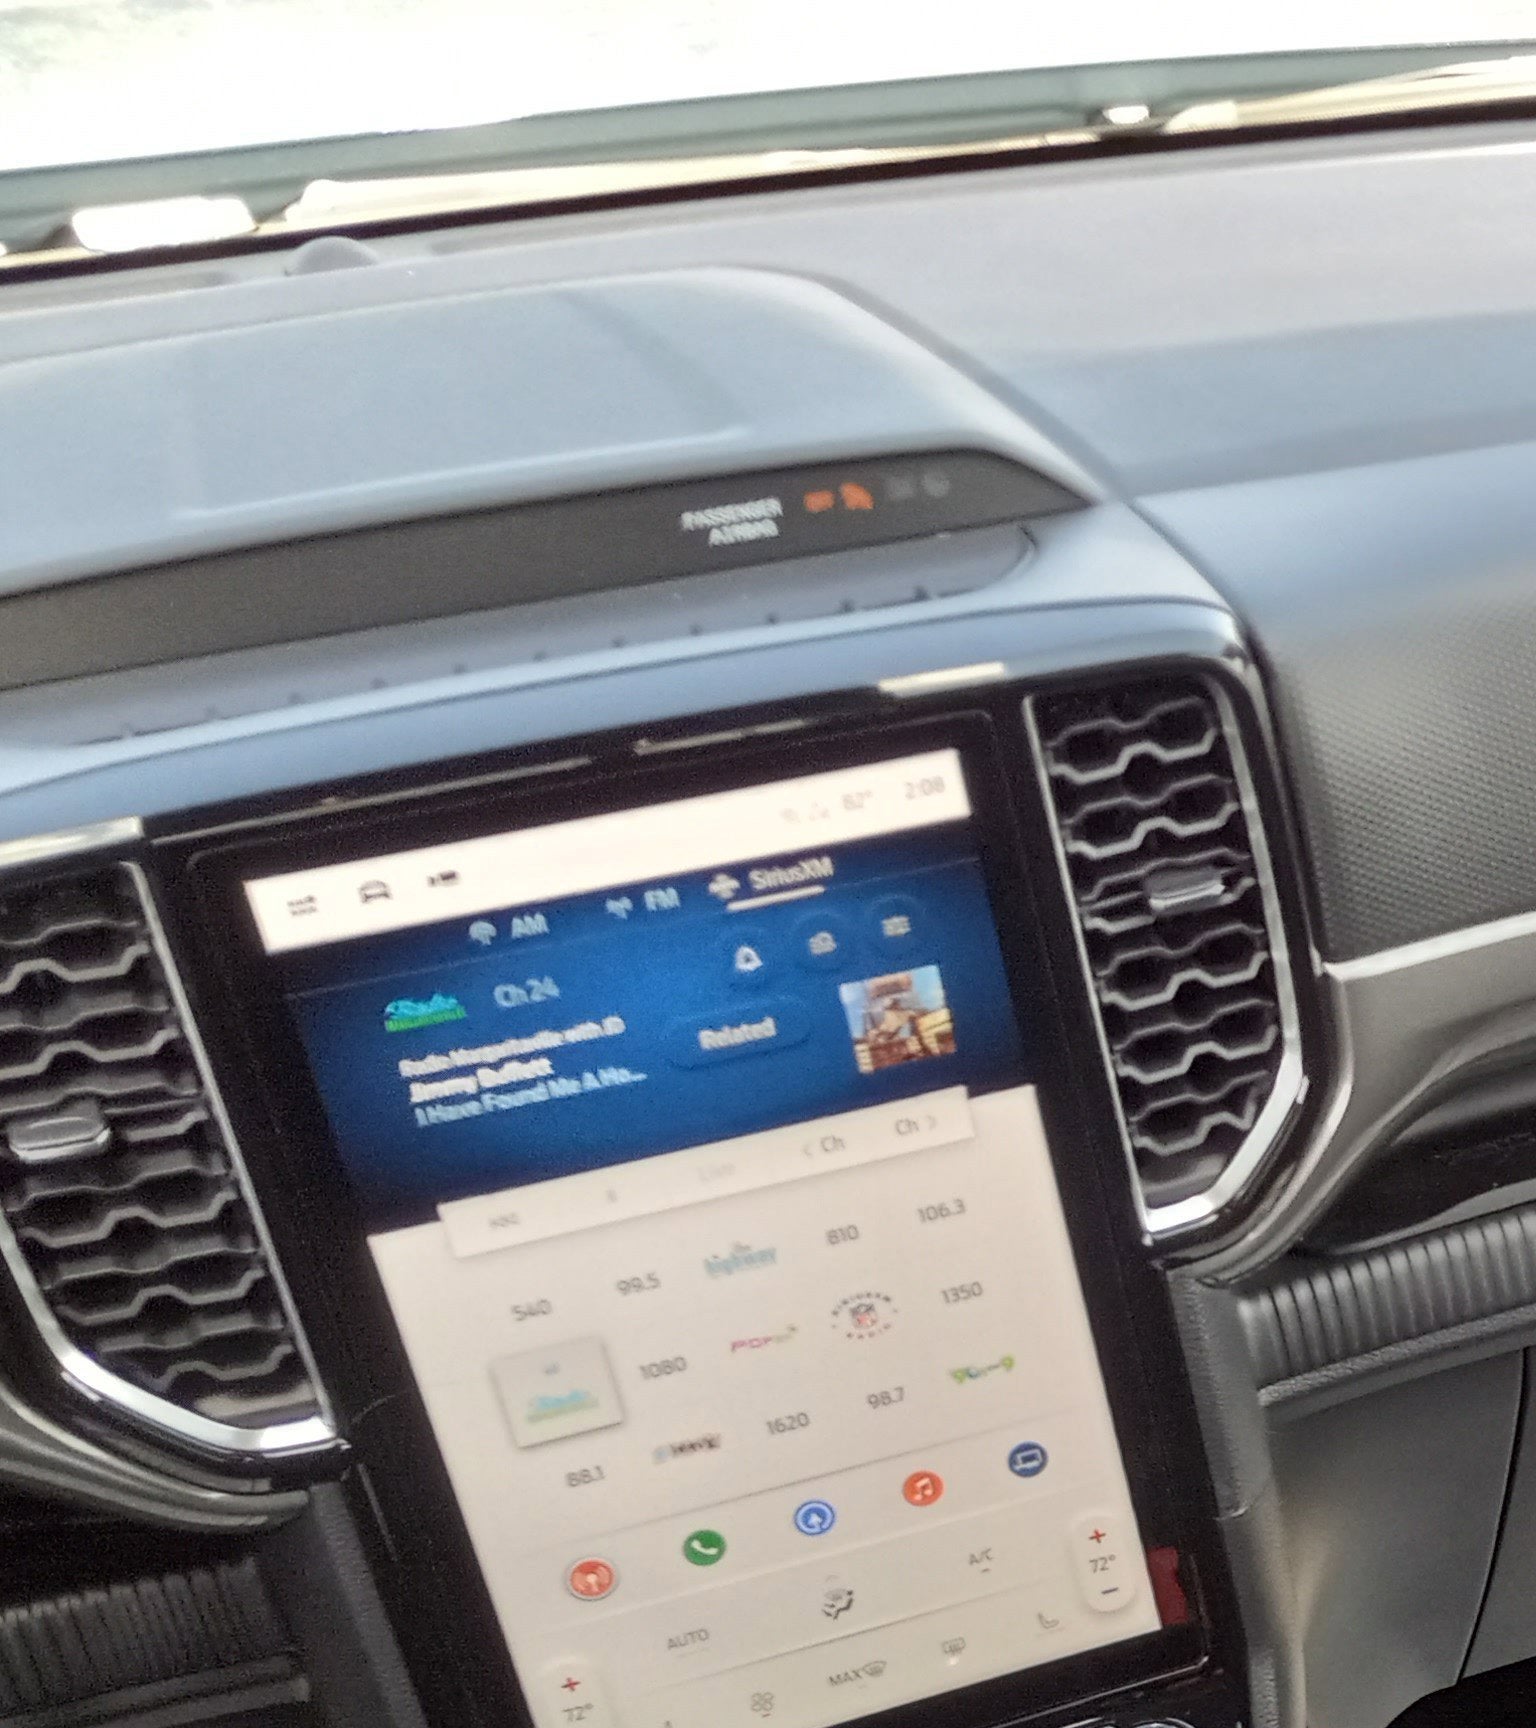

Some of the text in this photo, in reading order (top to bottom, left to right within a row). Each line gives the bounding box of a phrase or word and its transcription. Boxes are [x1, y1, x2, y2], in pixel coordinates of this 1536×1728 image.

[748, 856, 834, 892] SiriusXM
[644, 888, 681, 912] FM
[511, 912, 550, 939] AM
[916, 1198, 967, 1223] 106.3
[615, 1271, 662, 1295] 99.5
[940, 1281, 984, 1304] 1350
[639, 1355, 688, 1380] 1080
[866, 1386, 905, 1410] 98.7
[766, 1412, 811, 1435] 1620
[667, 1628, 710, 1650] AUTO
[826, 1669, 863, 1688] MAX
